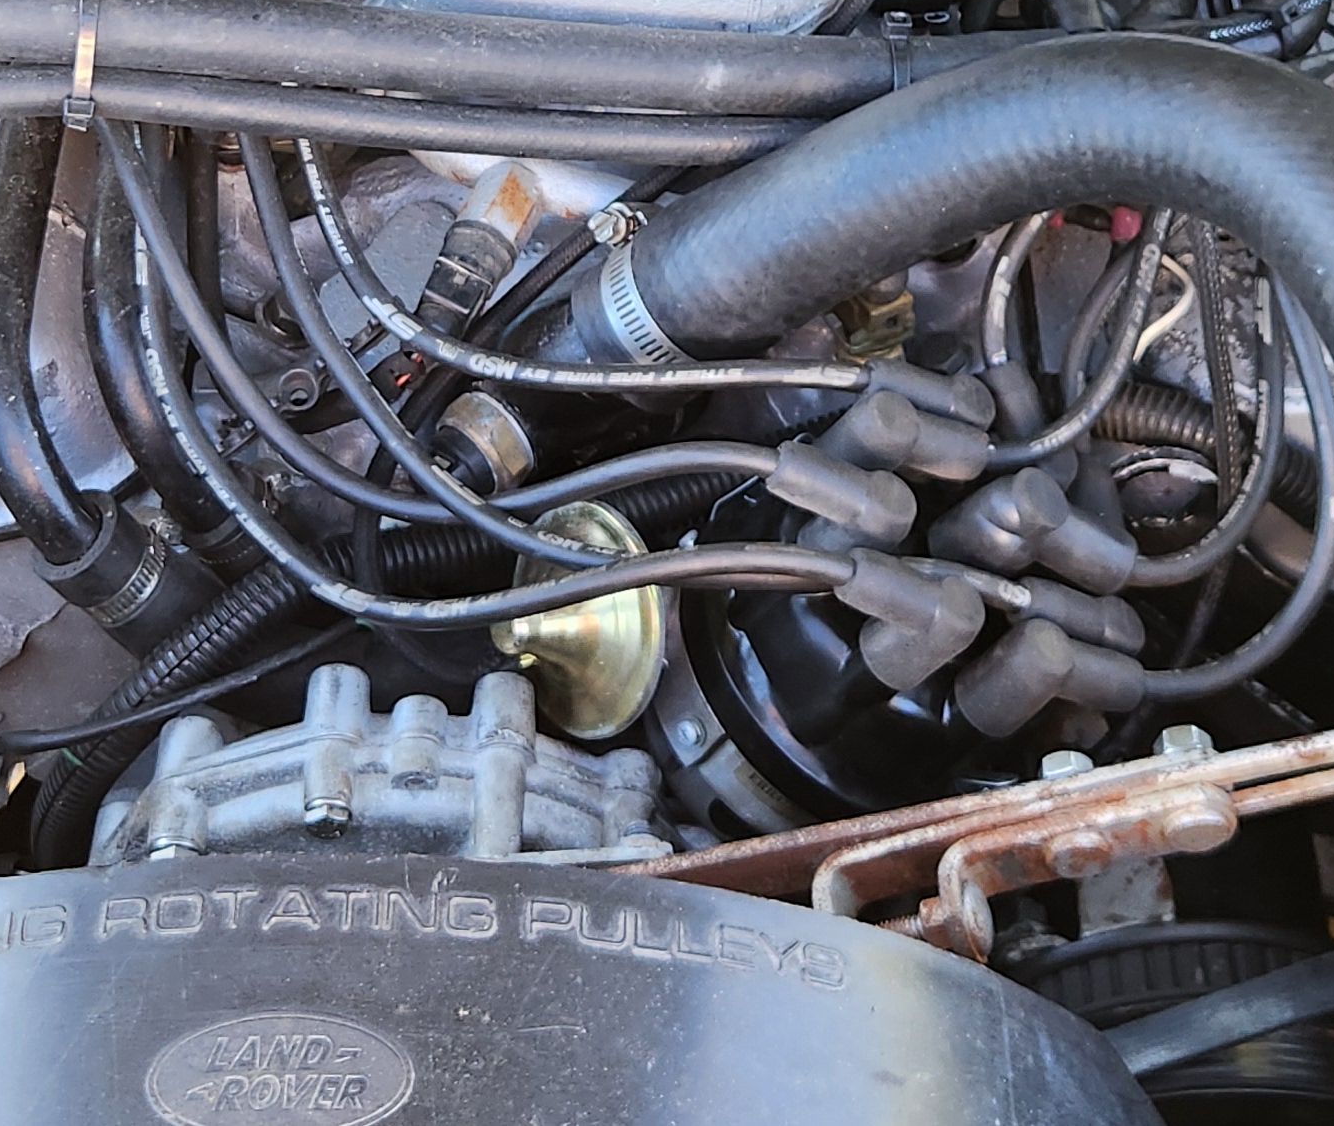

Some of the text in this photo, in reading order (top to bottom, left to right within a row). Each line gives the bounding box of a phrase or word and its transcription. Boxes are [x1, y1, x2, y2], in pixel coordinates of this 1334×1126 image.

[305, 162, 326, 201] FIRE
[317, 204, 354, 265] STREET
[145, 347, 170, 397] MSD
[468, 352, 519, 380] MSD
[520, 365, 551, 382] BY
[554, 369, 605, 385] WIRE
[607, 370, 657, 386] FIRE
[660, 367, 745, 383] STREET
[175, 431, 208, 474] WIRE
[205, 475, 237, 511] FIRE
[235, 512, 292, 563] STREET
[423, 596, 470, 619] MSD
[100, 885, 499, 939] ROTATING
[524, 896, 849, 992] PULLEYS
[212, 1074, 369, 1111] ROVER
